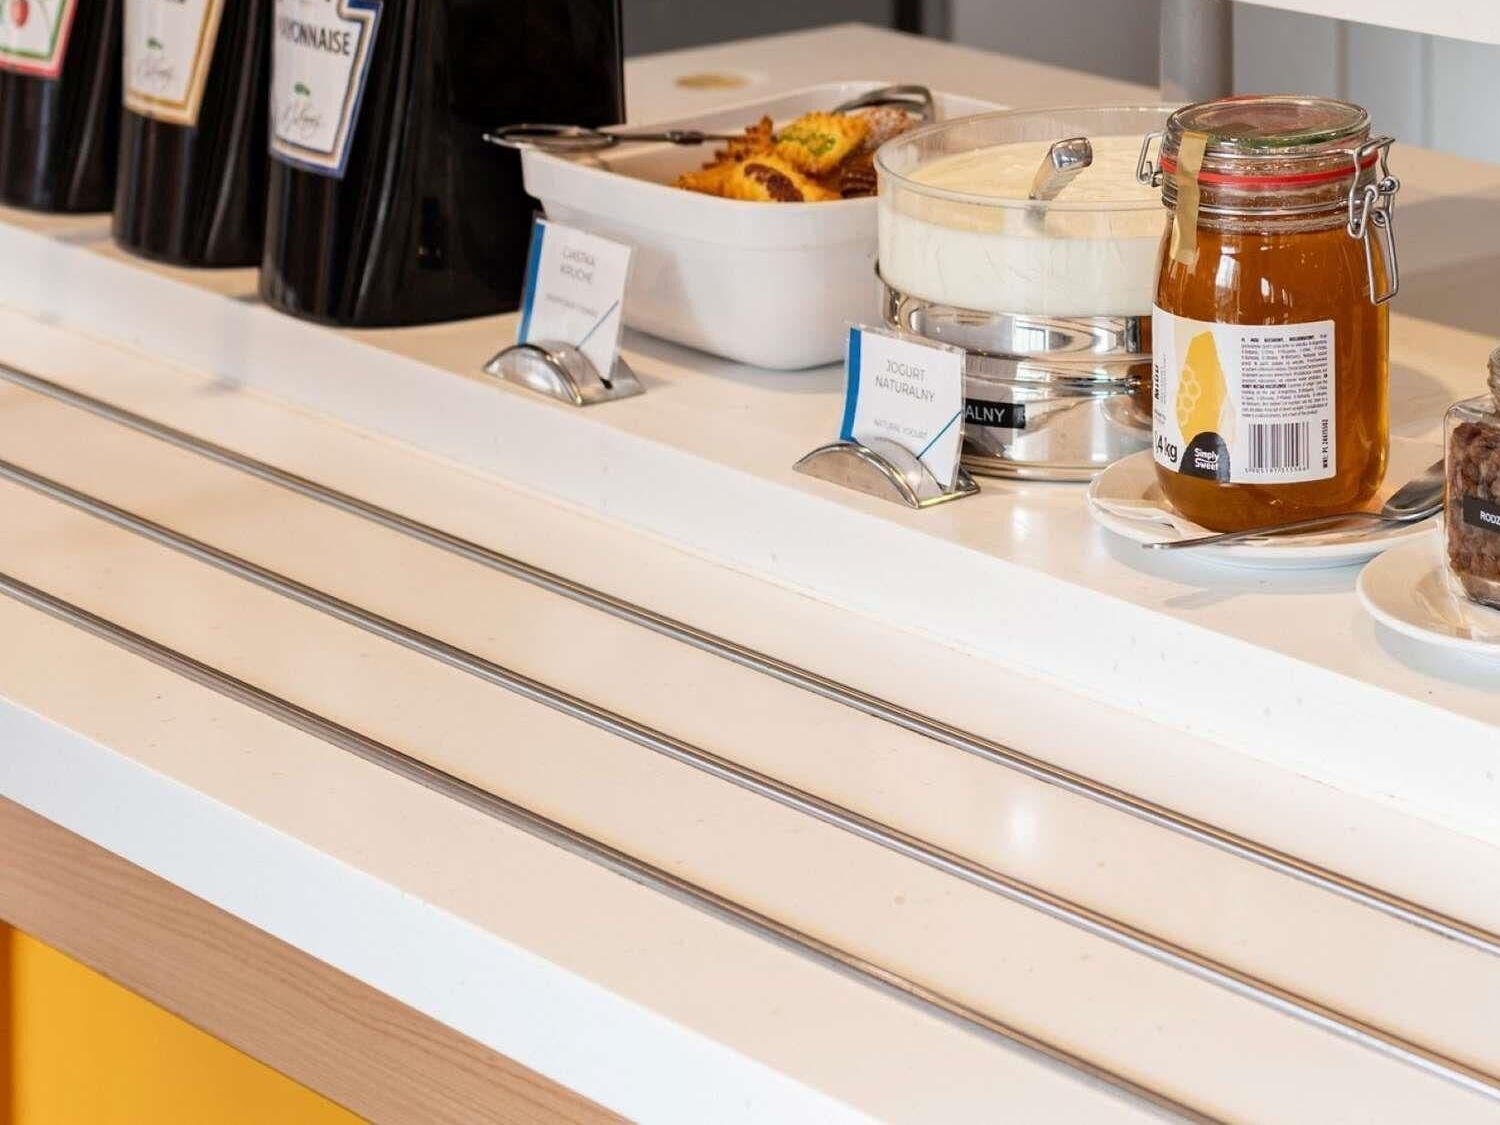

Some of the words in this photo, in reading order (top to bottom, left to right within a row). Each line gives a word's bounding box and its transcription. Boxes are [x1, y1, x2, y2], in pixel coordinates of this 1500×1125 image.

[886, 360, 927, 383] JOGURT
[875, 375, 936, 403] NATURALNY
[965, 405, 1005, 423] ALNY
[1164, 437, 1178, 463] kg
[1194, 448, 1219, 463] Simply
[1194, 457, 1218, 471] Sweet
